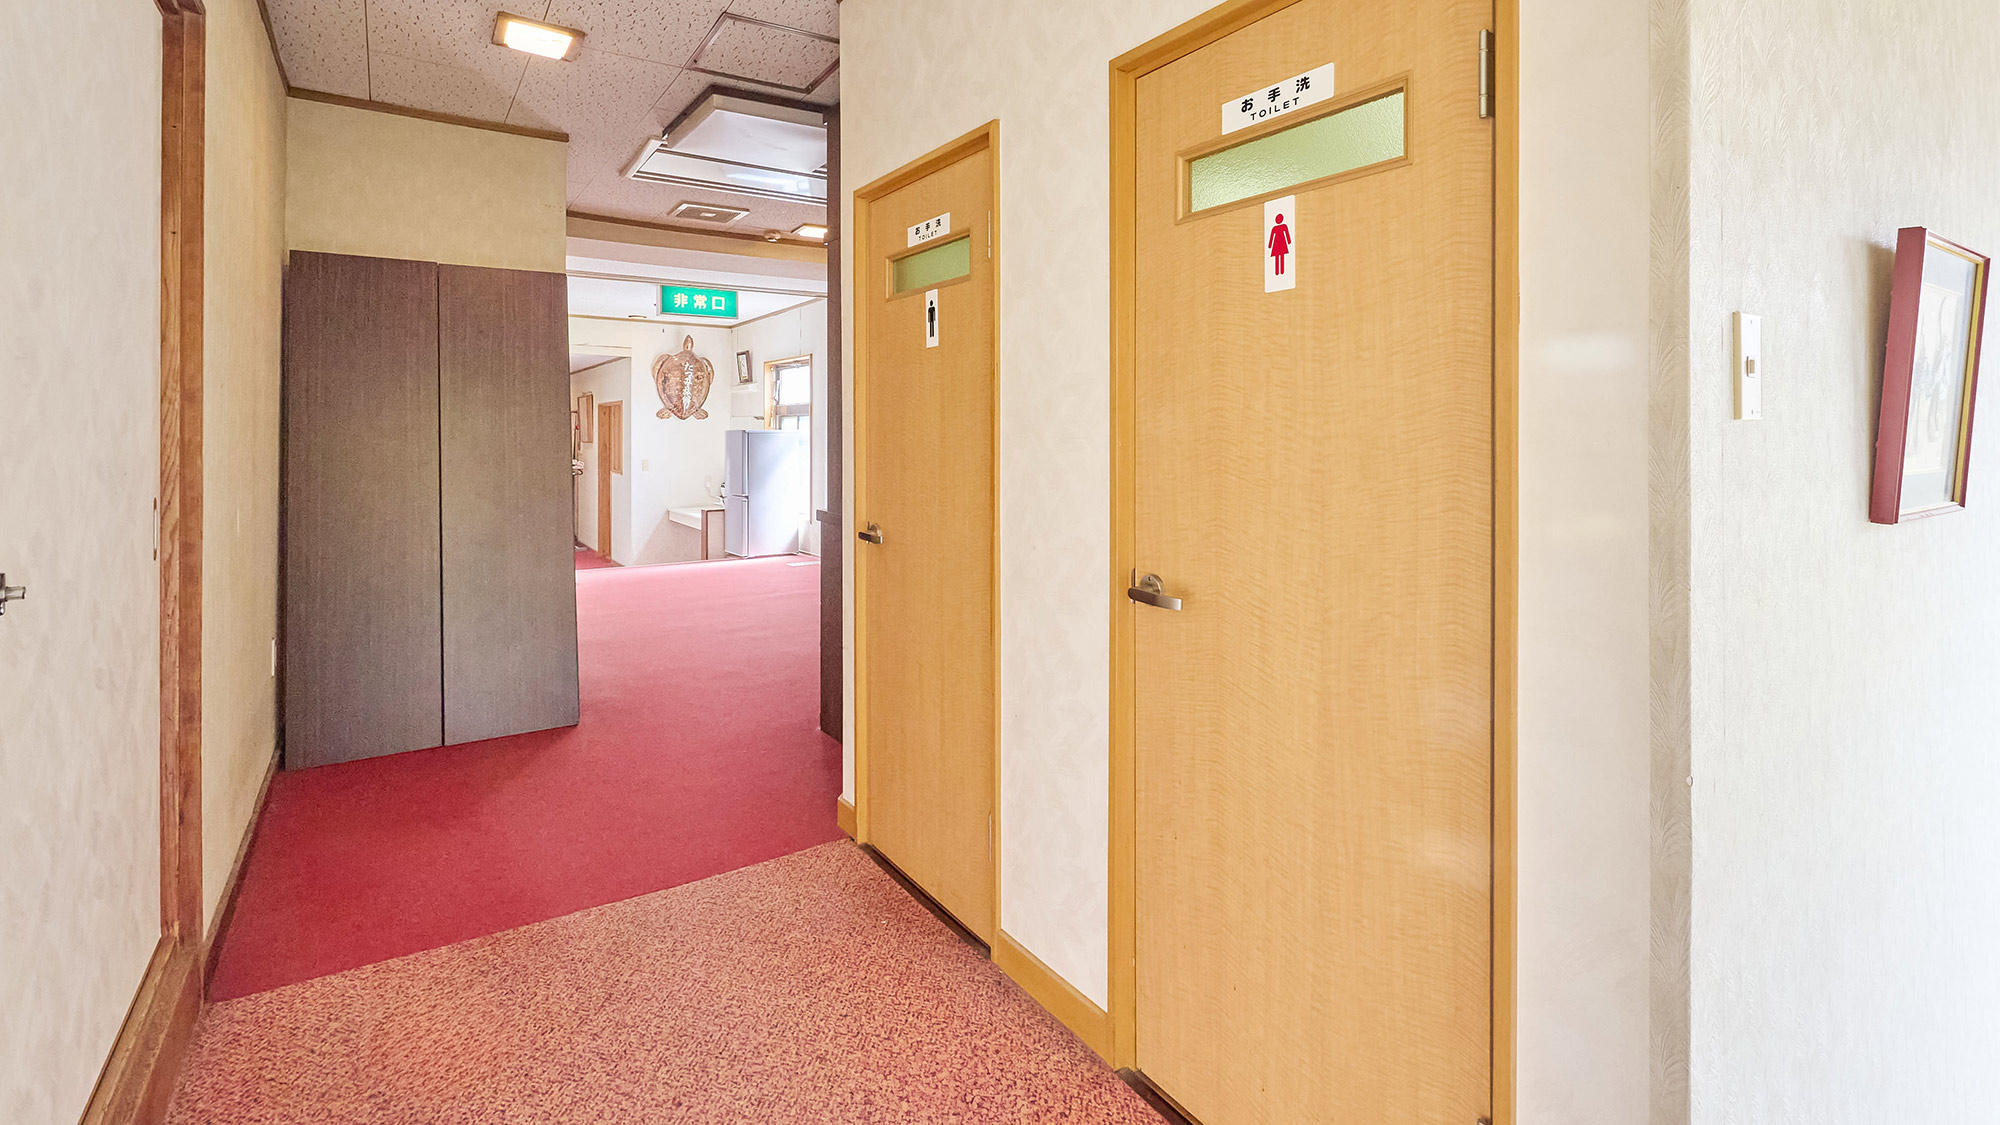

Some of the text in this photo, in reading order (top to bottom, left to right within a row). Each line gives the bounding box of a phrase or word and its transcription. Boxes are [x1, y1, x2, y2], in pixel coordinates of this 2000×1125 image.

[1241, 76, 1311, 112] お手洗
[1250, 97, 1300, 120] TOILET
[673, 293, 725, 311] 非常口
